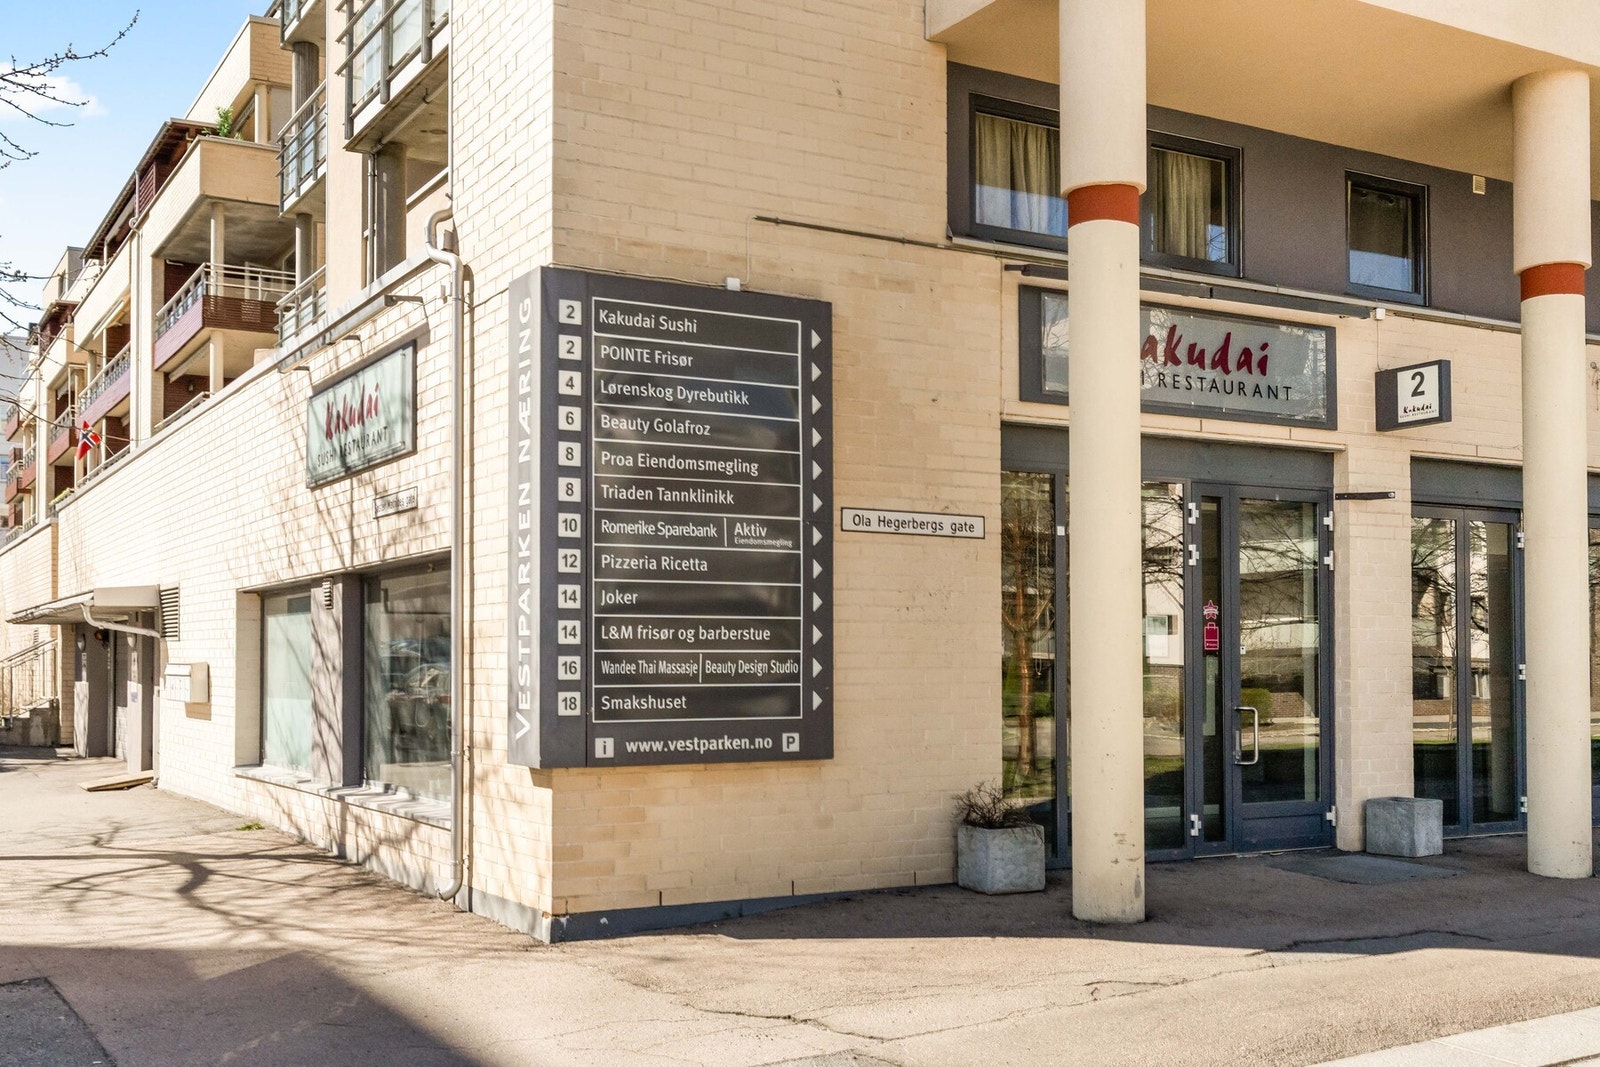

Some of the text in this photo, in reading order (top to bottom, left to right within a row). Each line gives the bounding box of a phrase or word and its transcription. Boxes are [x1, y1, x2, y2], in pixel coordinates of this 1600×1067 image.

[566, 305, 575, 319] 2
[599, 308, 697, 333] Kakudai Sushi
[566, 341, 575, 355] 2
[601, 345, 693, 368] POINTE Frisør
[1140, 324, 1269, 377] akudai
[566, 377, 575, 390] 4
[1158, 372, 1292, 401] RESTAURANT
[1411, 371, 1425, 397] 2
[601, 380, 750, 406] Lørenskog Dyrebutikk
[326, 382, 379, 440] Kakudai
[566, 412, 574, 425] 6
[601, 415, 711, 437] Beauty Golafroz
[566, 448, 574, 461] 8
[601, 451, 759, 476] Proa Eiendomsmegling
[566, 483, 574, 496] 8
[601, 485, 735, 505] Triaden Tannklinikk
[516, 297, 531, 740] VESTPARKEN NÆRING
[562, 519, 577, 532] 10
[853, 514, 975, 534] Ola Hegerbergs gate
[601, 520, 718, 538] Romerike Sparebank
[734, 523, 767, 538] Aktiv
[734, 537, 793, 548] Eiendomsmegling
[562, 554, 577, 568] 12
[601, 554, 708, 572] Pizzeria Ricetta
[562, 589, 577, 603] 14
[601, 589, 638, 605] Joker
[562, 625, 577, 639] 14
[601, 625, 771, 643] L&M frisør og barberstue
[562, 661, 577, 675] 16
[601, 660, 698, 677] Wandee Thai Massasje
[705, 660, 799, 677] Beauty Design Studio
[562, 696, 577, 710] 18
[601, 695, 687, 711] Smakshuset
[625, 735, 773, 754] www.vestparken.no
[786, 736, 796, 749] P
